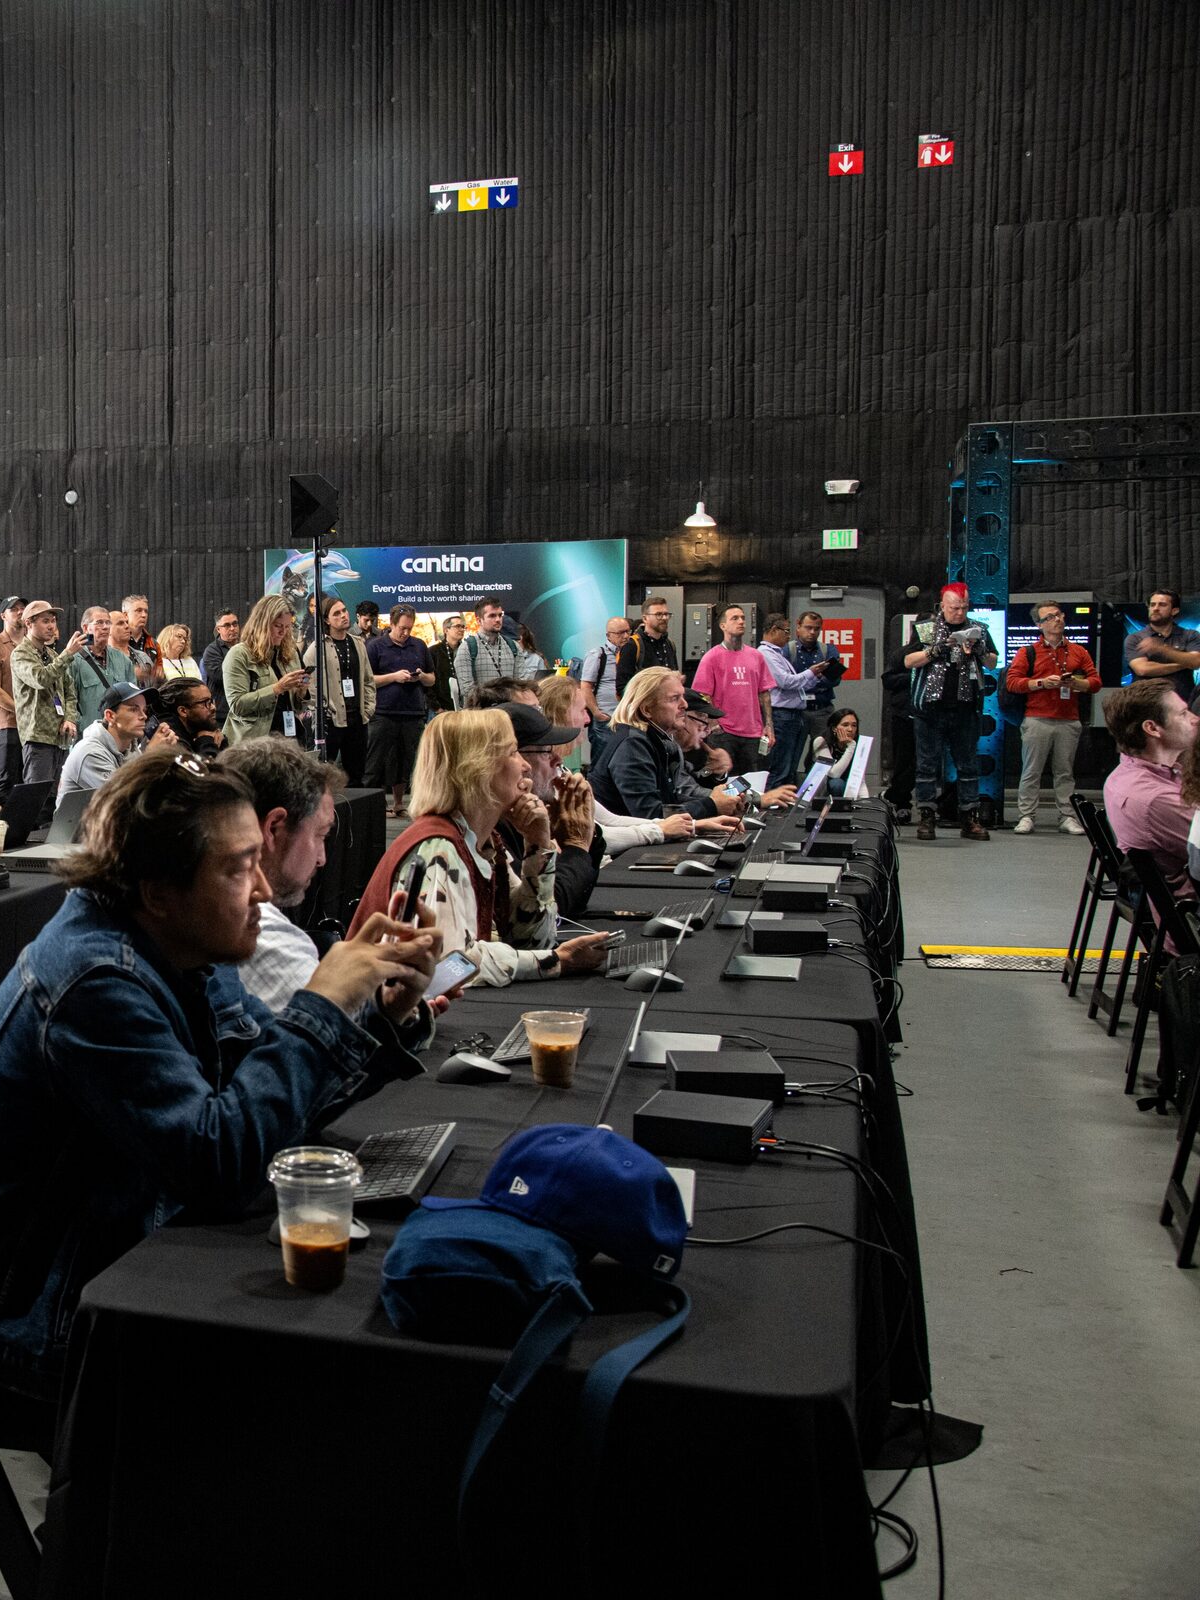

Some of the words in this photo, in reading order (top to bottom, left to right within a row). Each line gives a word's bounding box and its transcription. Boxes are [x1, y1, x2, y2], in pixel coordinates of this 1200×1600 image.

[838, 144, 854, 152] Exit
[829, 530, 853, 548] EXIT
[401, 554, 484, 573] cantina
[372, 584, 397, 594] Every
[398, 584, 431, 593] Cantina
[432, 583, 449, 592] Has
[450, 583, 464, 592] it's
[464, 582, 513, 591] Characters
[817, 630, 854, 645] IRE
